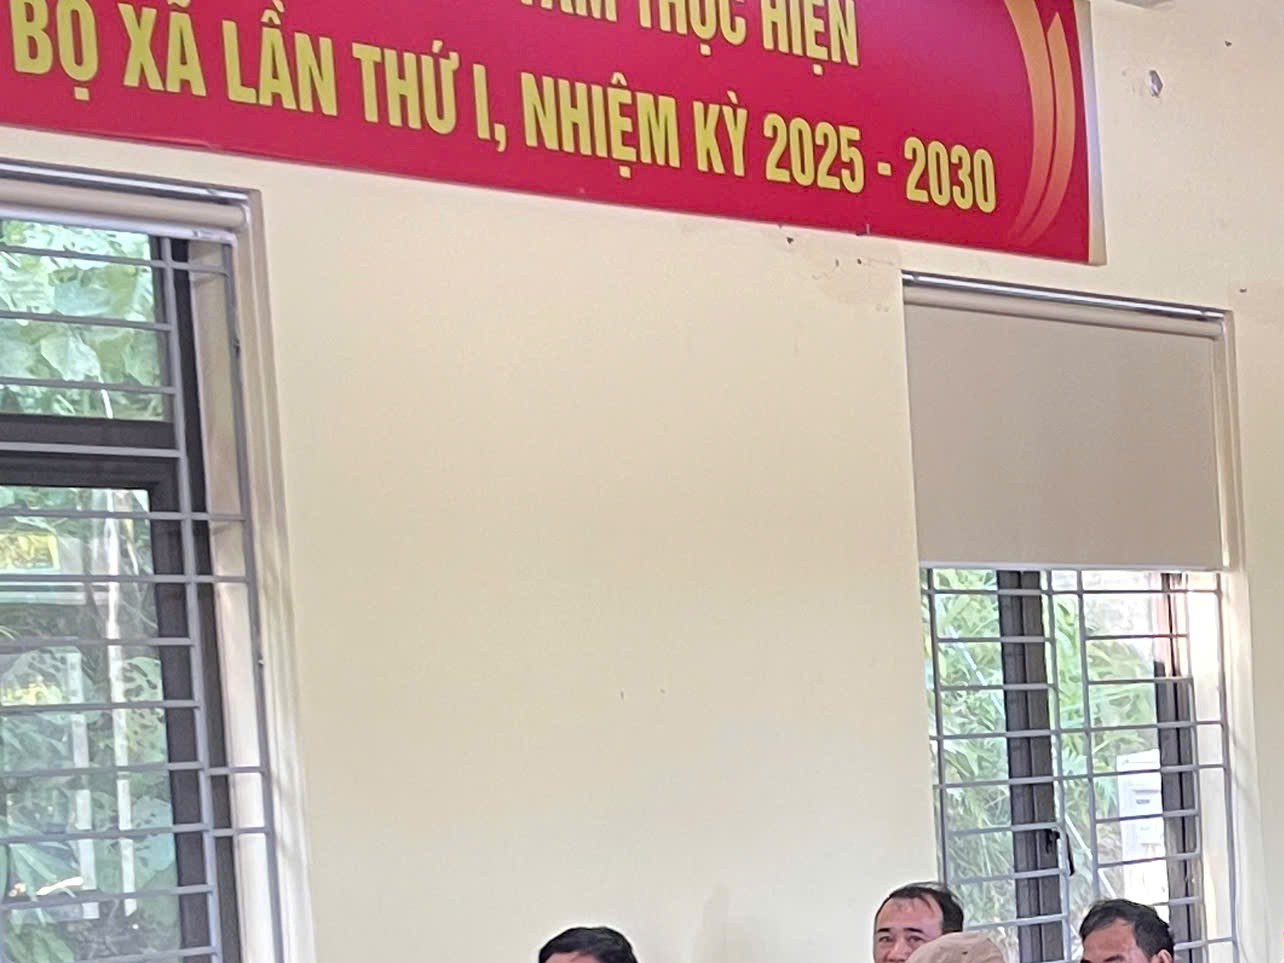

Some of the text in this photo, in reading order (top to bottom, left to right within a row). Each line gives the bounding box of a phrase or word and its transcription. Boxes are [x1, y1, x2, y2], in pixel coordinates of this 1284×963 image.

[117, 0, 207, 98] XÃ
[221, 0, 339, 117] LẦN
[351, 39, 460, 136] THỨ
[472, 63, 507, 152] I,
[520, 71, 681, 179] NHIỆM
[692, 90, 748, 178] KỲ
[763, 113, 865, 194] 2025
[877, 161, 892, 176] -
[904, 136, 997, 214] 2030
